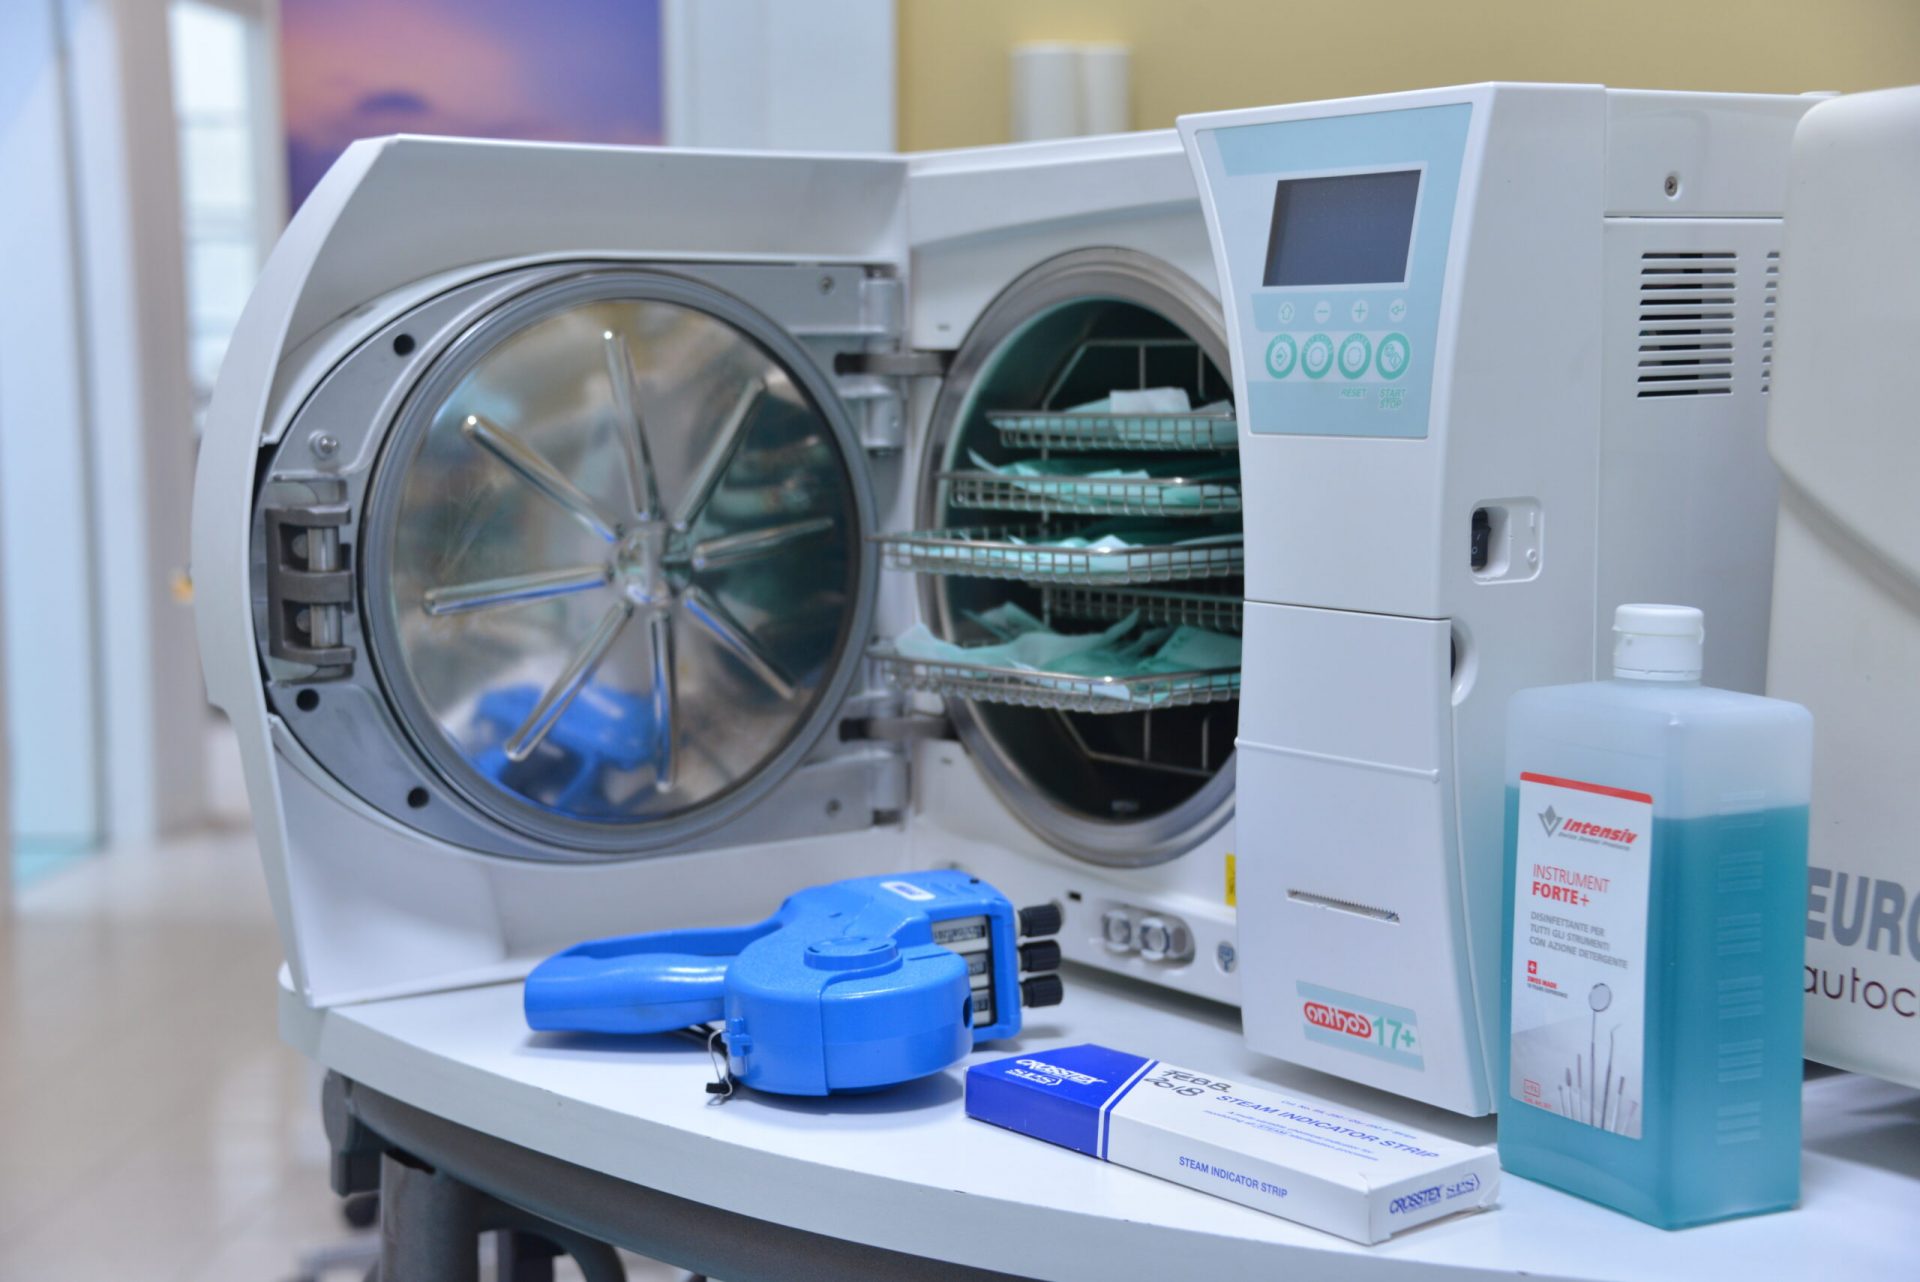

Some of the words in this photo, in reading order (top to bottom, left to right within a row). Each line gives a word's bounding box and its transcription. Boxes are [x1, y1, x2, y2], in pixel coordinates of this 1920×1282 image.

[1341, 388, 1367, 398] RESET
[1379, 388, 1406, 398] START
[1379, 398, 1402, 409] STOP
[1562, 818, 1638, 844] Intensiv
[1533, 864, 1611, 893] INSTRUMENT
[1532, 881, 1590, 907] FORTE+
[1530, 911, 1589, 933] DISINFETTANTE
[1590, 925, 1605, 937] PER
[1530, 923, 1550, 936] TUTTI
[1551, 928, 1565, 940] GLI
[1567, 932, 1610, 951] STRUMENTI
[1529, 935, 1546, 948] CON
[1547, 940, 1577, 955] AZIONE
[1578, 948, 1628, 969] DETERGENTE
[1373, 1016, 1416, 1050] 17+
[1143, 1077, 1206, 1097] 2018
[1216, 1095, 1279, 1114] STEAM
[1278, 1111, 1380, 1142] INDICATOR
[1379, 1140, 1440, 1158] STRIP
[1179, 1156, 1209, 1174] STEAM
[1211, 1166, 1259, 1190] INDICATOR
[1260, 1182, 1288, 1198] STRIP
[1389, 1186, 1442, 1215] CROSSTEX
